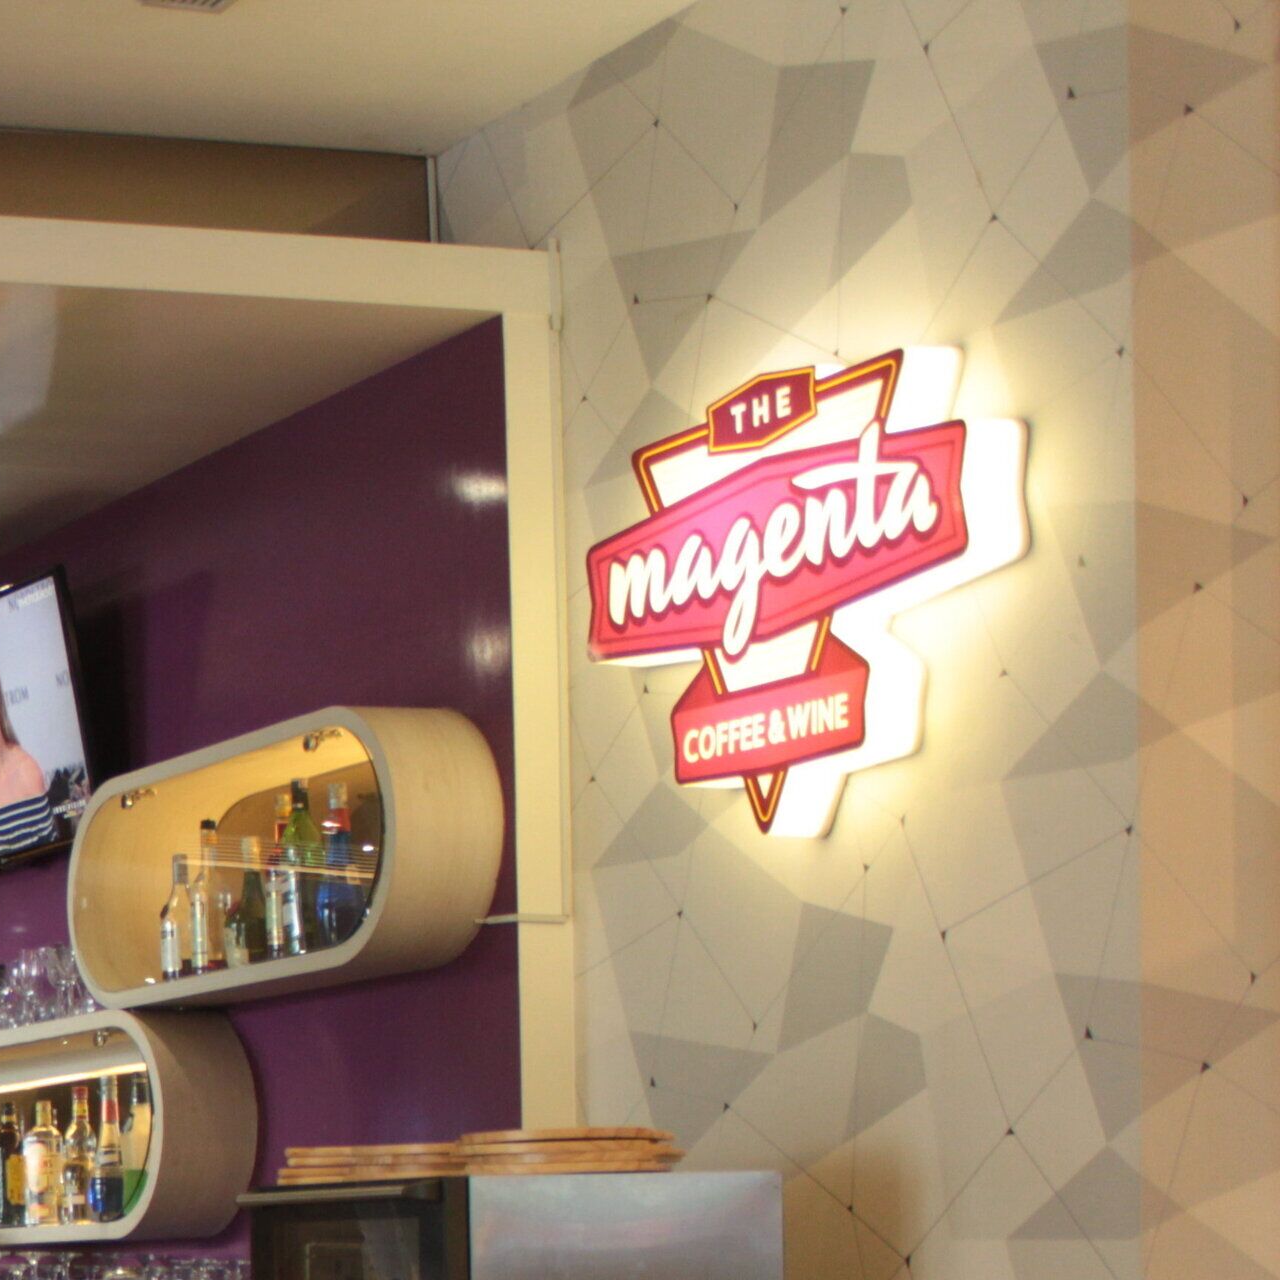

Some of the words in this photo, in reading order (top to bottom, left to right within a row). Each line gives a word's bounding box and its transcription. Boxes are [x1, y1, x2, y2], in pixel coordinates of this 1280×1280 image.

[729, 387, 792, 434] THE
[608, 420, 939, 656] magenta
[683, 713, 765, 764] COFFEE
[768, 709, 786, 745] &
[786, 693, 849, 740] WINE
